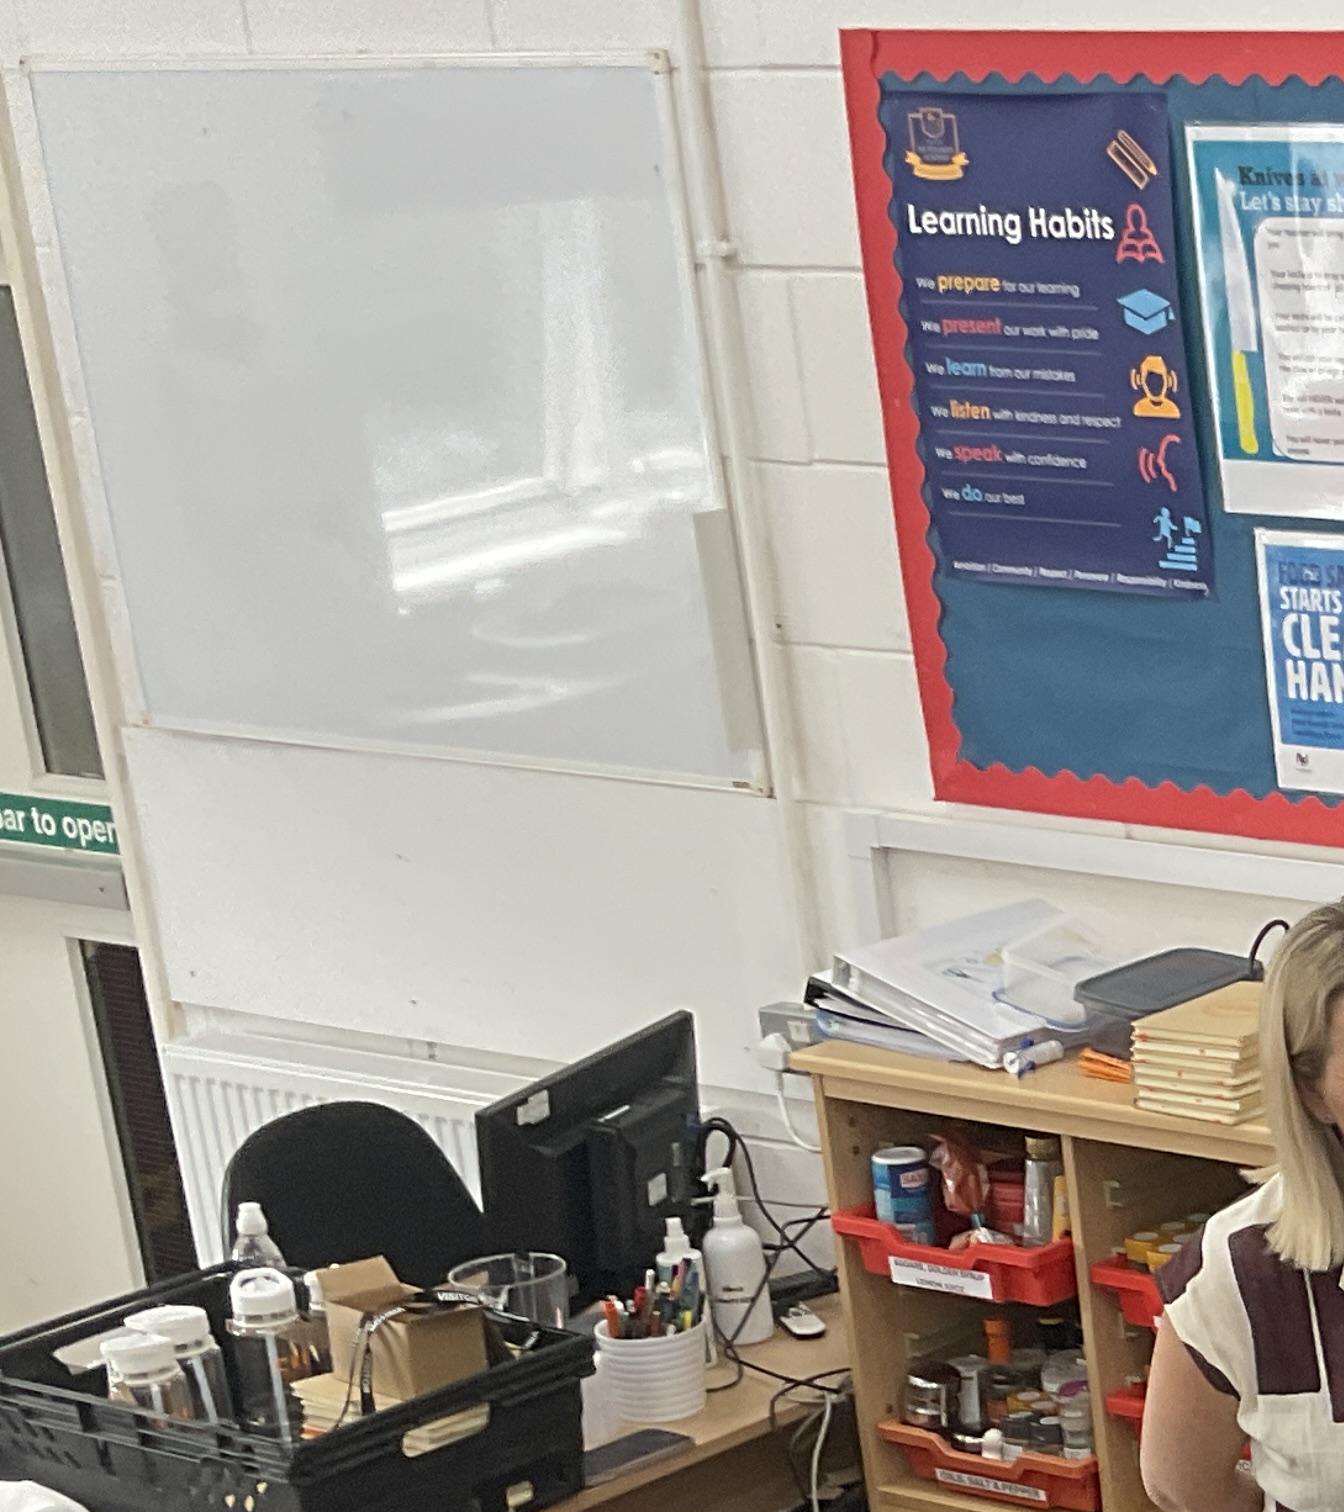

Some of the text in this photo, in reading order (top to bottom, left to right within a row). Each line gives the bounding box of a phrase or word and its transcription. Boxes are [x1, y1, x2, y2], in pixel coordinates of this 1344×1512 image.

[1238, 166, 1304, 186] Knives
[1240, 190, 1281, 212] Let's
[1286, 191, 1322, 216] stay
[907, 203, 1115, 244] Learning Habits
[937, 275, 1000, 295] prepare
[1037, 281, 1080, 298] learning
[941, 317, 1002, 335] present
[945, 356, 987, 377] learn
[950, 399, 992, 420] listen
[953, 444, 1002, 463] speak
[1027, 453, 1087, 468] confidence
[961, 483, 983, 502] do
[1280, 585, 1343, 614] STARTS
[0, 808, 25, 832] ar
[31, 807, 56, 836] to
